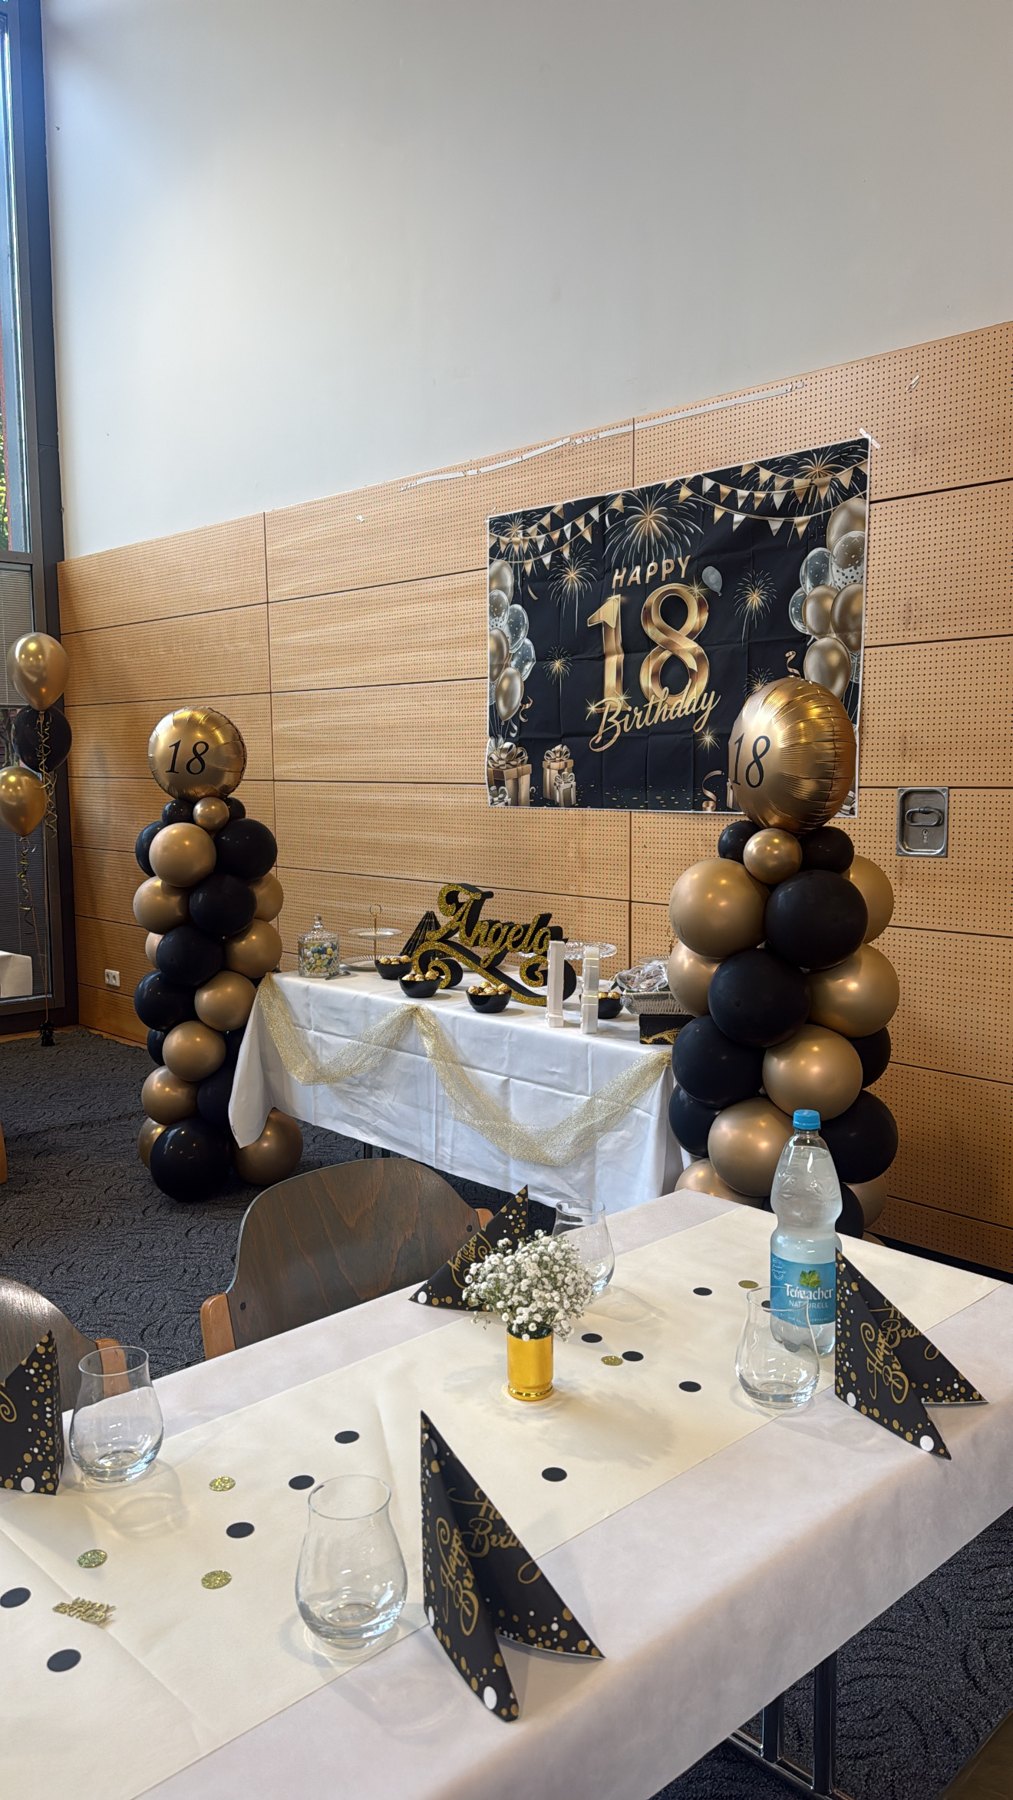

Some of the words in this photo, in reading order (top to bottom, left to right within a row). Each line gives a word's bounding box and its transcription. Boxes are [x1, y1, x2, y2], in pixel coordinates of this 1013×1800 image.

[611, 555, 691, 589] HAPPY
[587, 583, 710, 713] 18
[588, 678, 721, 752] Birthday
[165, 739, 210, 775] 18
[733, 732, 771, 789] 18
[425, 882, 560, 968] Angela
